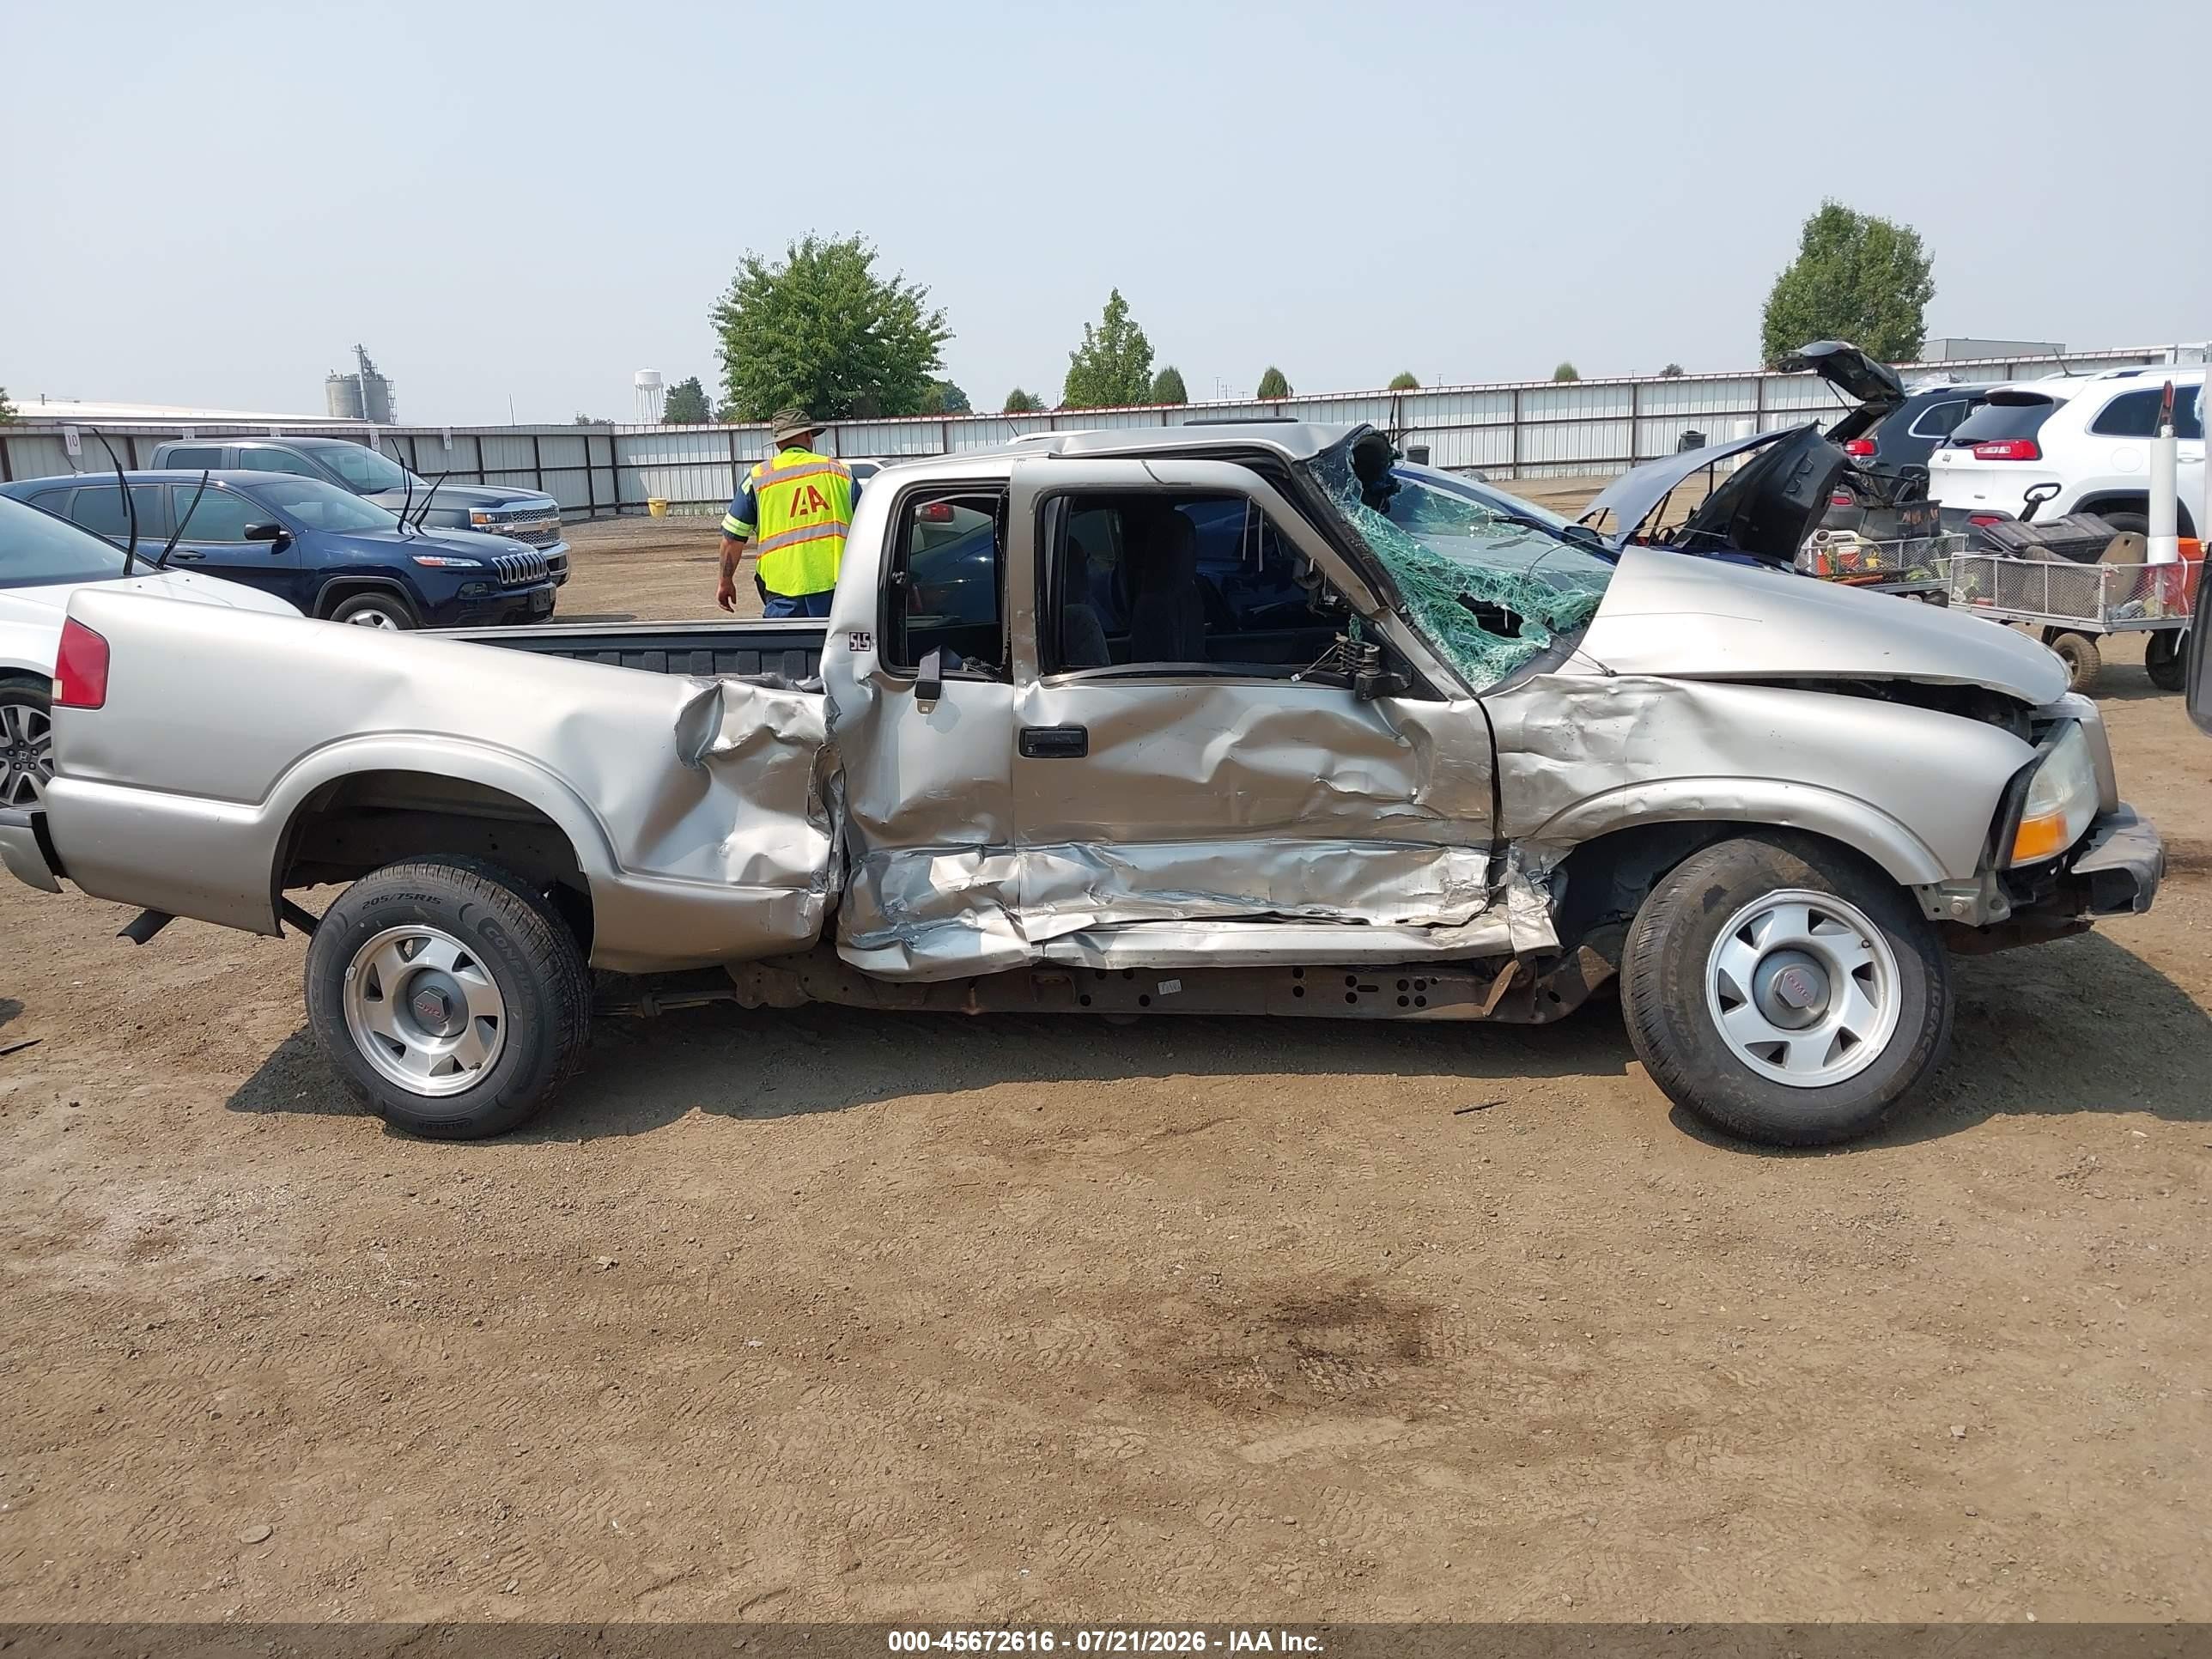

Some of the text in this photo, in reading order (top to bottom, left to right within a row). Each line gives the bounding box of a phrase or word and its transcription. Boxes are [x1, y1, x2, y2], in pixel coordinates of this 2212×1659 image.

[68, 434, 78, 447] 10
[371, 434, 379, 446] 13
[849, 632, 871, 651] SLS
[362, 893, 444, 910] 205/75R15
